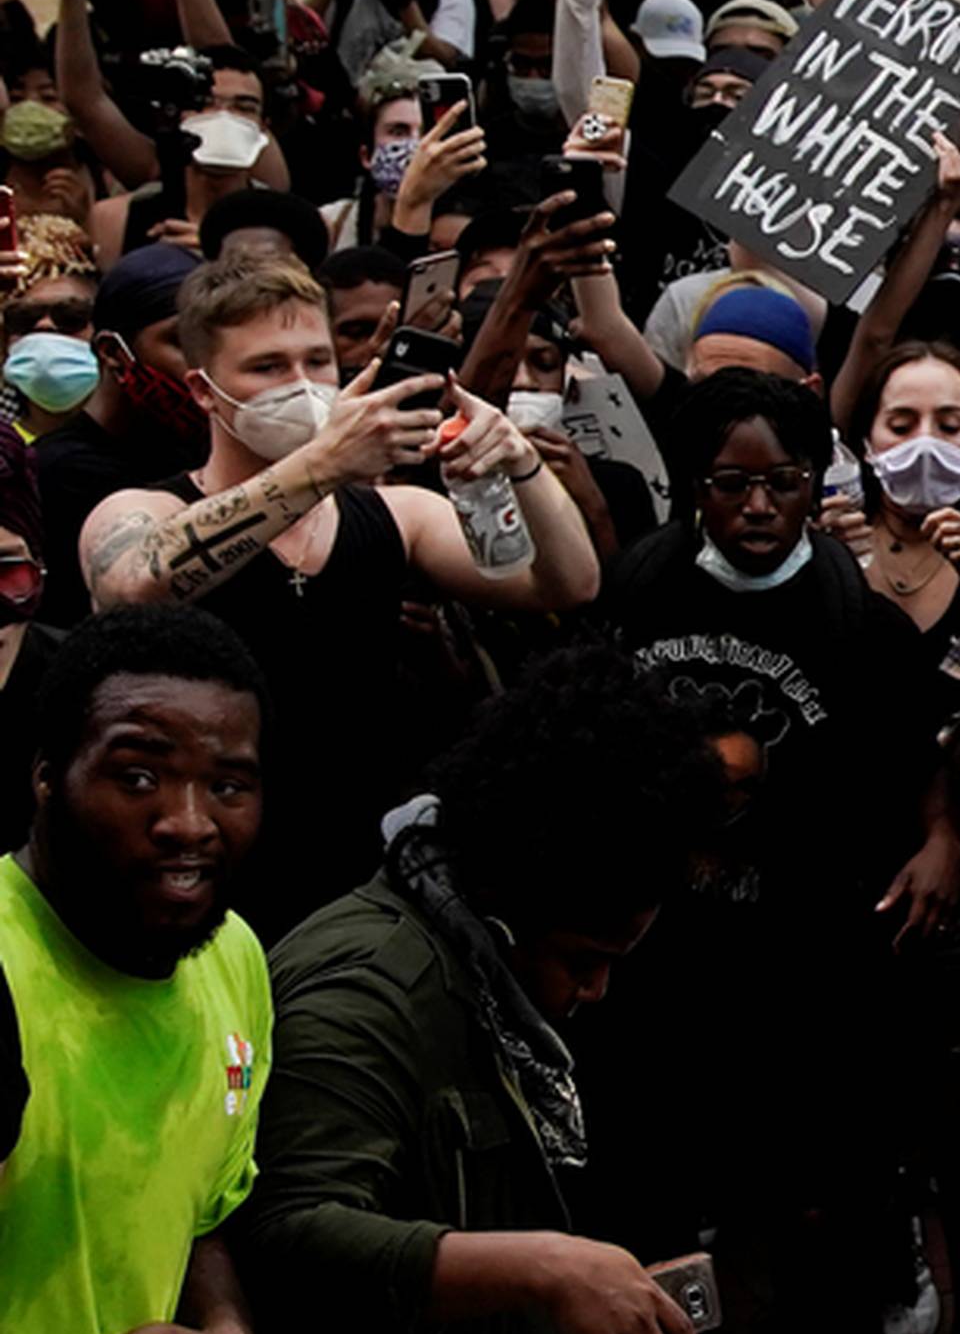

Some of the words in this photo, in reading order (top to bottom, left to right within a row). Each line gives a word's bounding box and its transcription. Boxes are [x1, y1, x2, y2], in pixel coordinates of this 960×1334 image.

[793, 30, 863, 82] IN
[752, 82, 921, 206] WHITE
[714, 151, 898, 274] HOUSE
